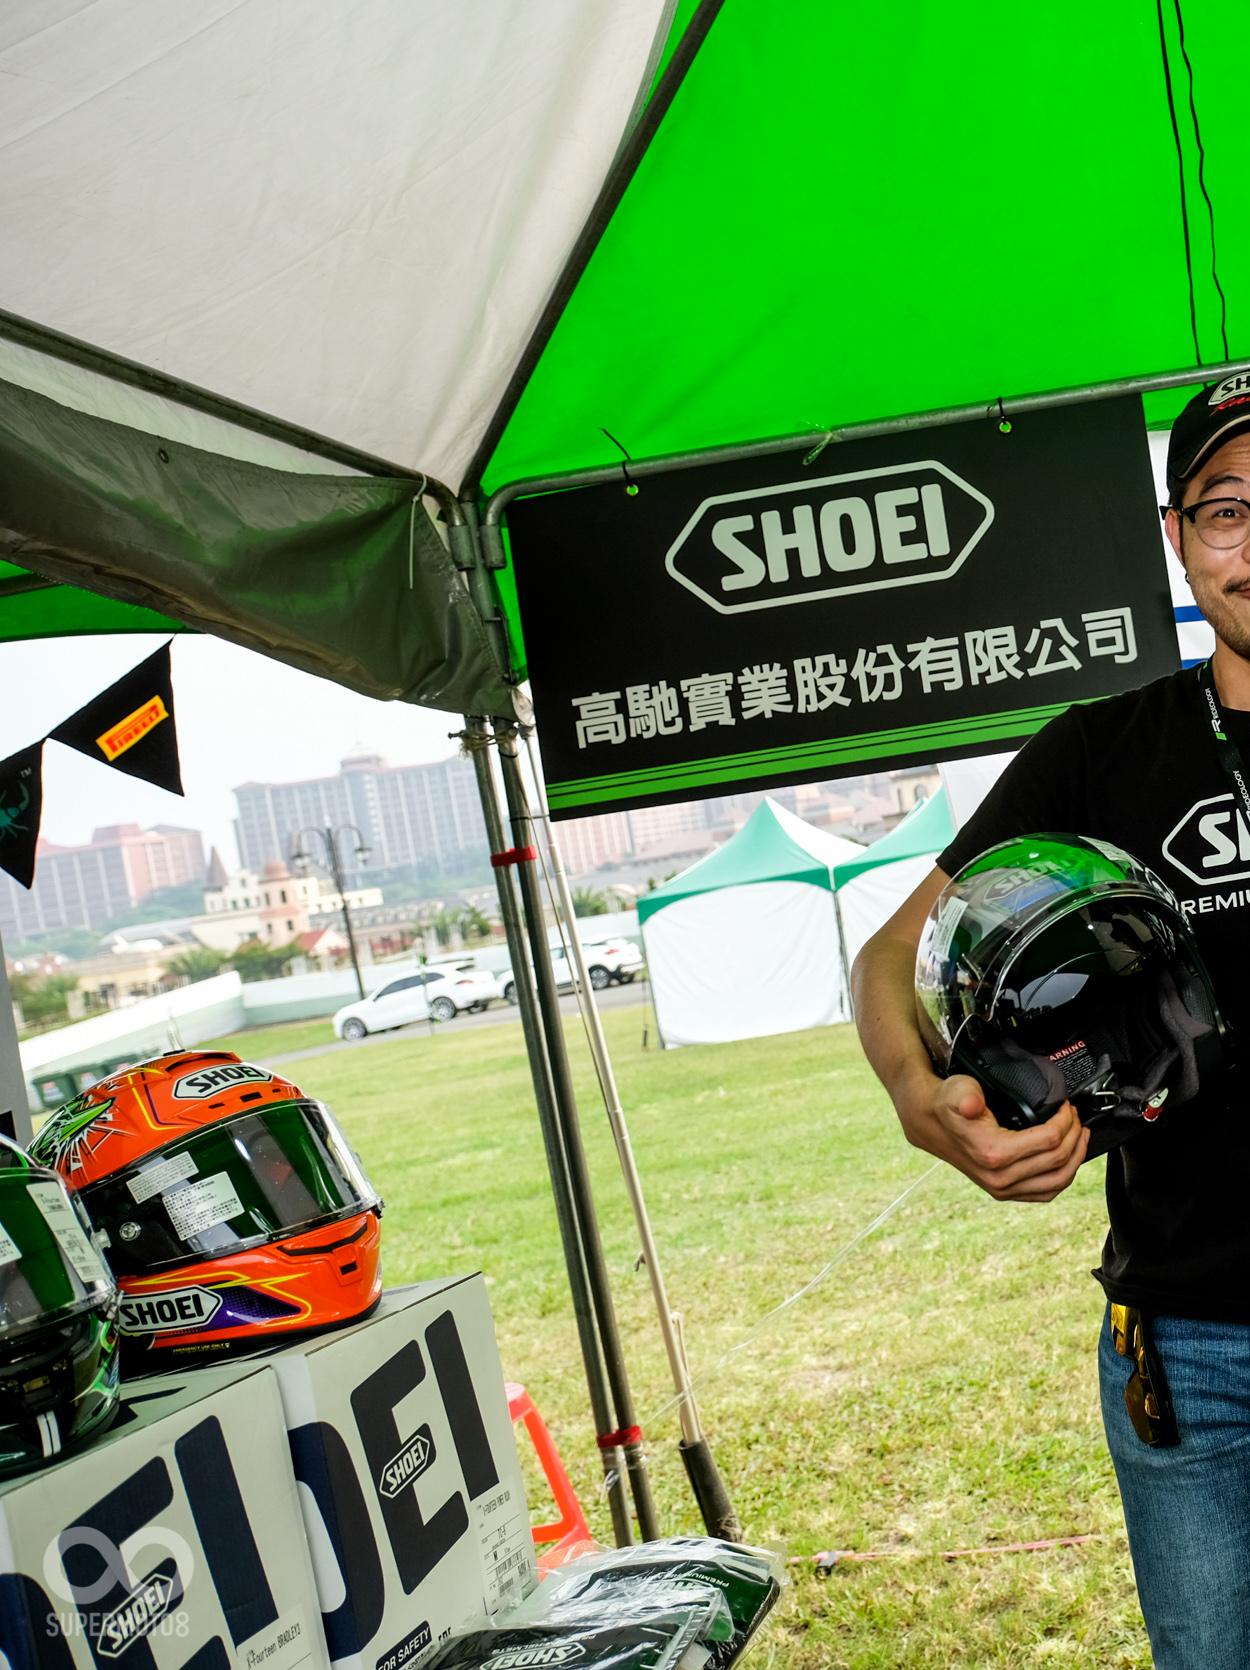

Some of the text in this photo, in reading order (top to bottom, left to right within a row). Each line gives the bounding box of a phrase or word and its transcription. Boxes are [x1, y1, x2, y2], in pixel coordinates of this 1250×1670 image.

[711, 483, 950, 592] SHOEI
[571, 607, 1139, 749] 高馳實業股份有限公司
[105, 703, 161, 753] PIRELLI
[1048, 1041, 1086, 1061] ARNING
[186, 1066, 265, 1093] SHOEI
[119, 1294, 204, 1327] SHOEI
[385, 1441, 425, 1493] SHOEI
[106, 1580, 166, 1650] SHOEI
[398, 1627, 429, 1662] SAFETY
